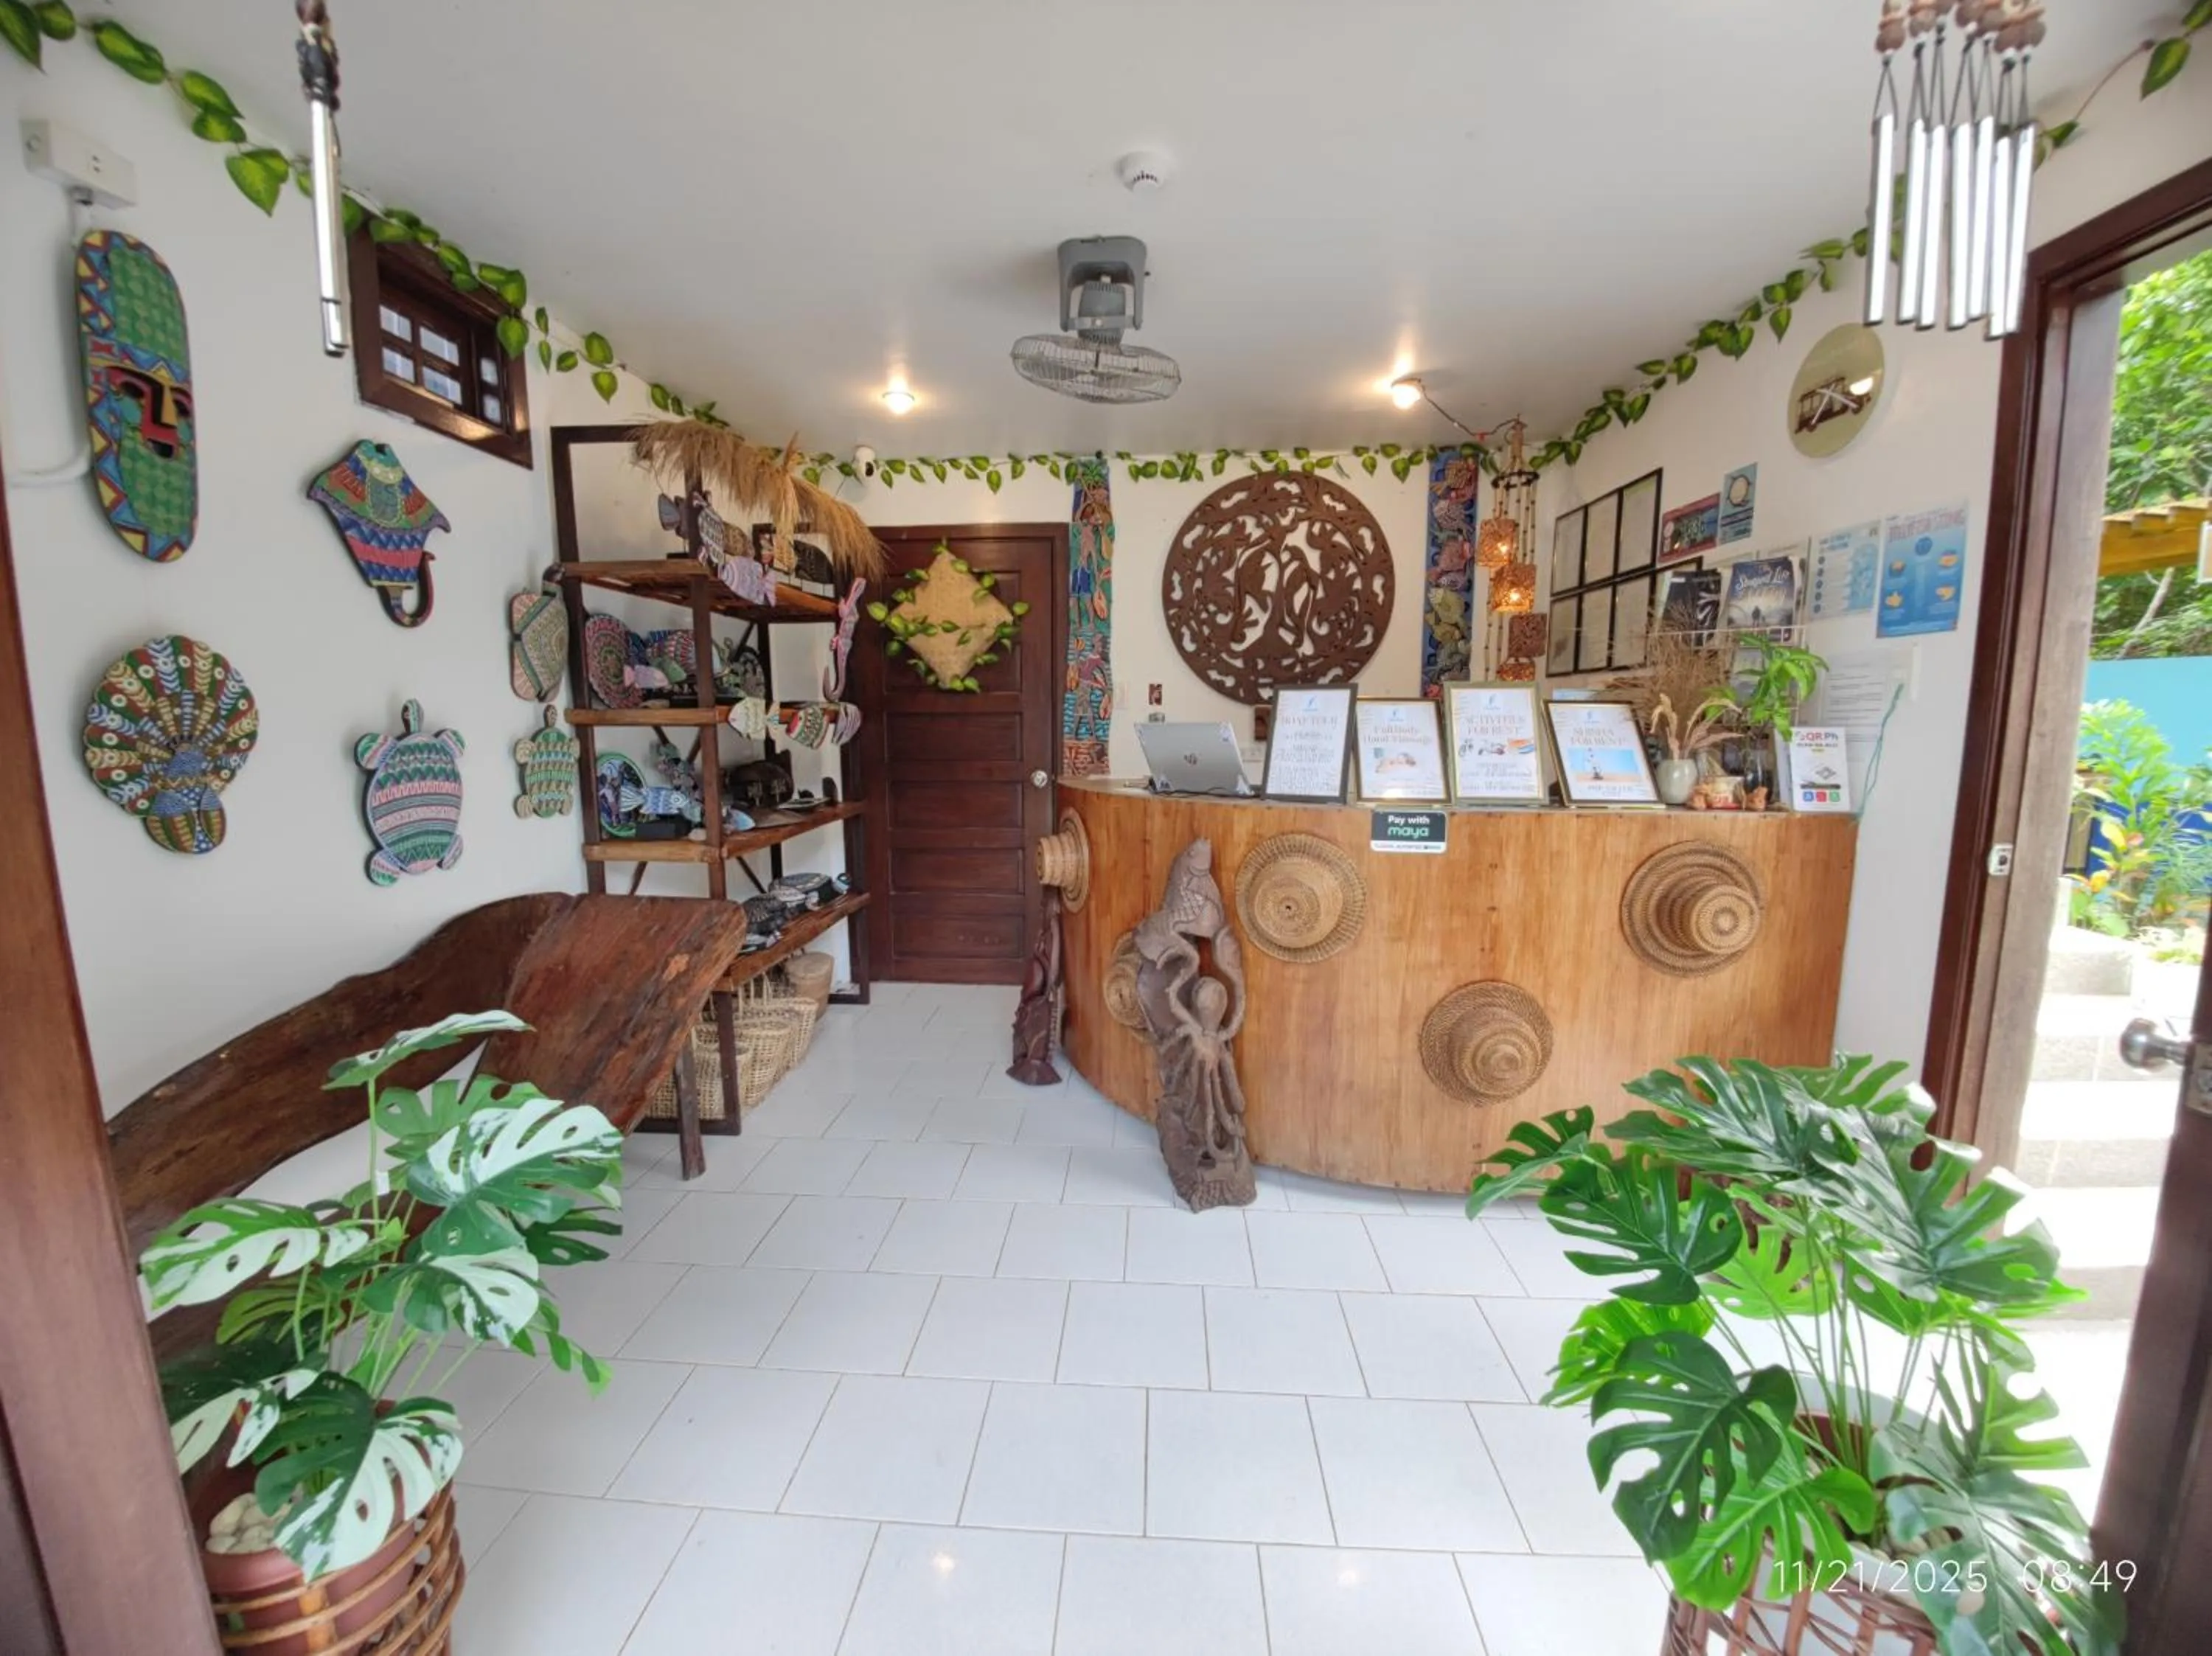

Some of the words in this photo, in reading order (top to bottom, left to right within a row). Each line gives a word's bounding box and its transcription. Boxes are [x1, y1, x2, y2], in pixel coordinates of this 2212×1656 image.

[1388, 815, 1405, 826] Pay
[1408, 815, 1430, 824] with
[1388, 827, 1429, 839] maya
